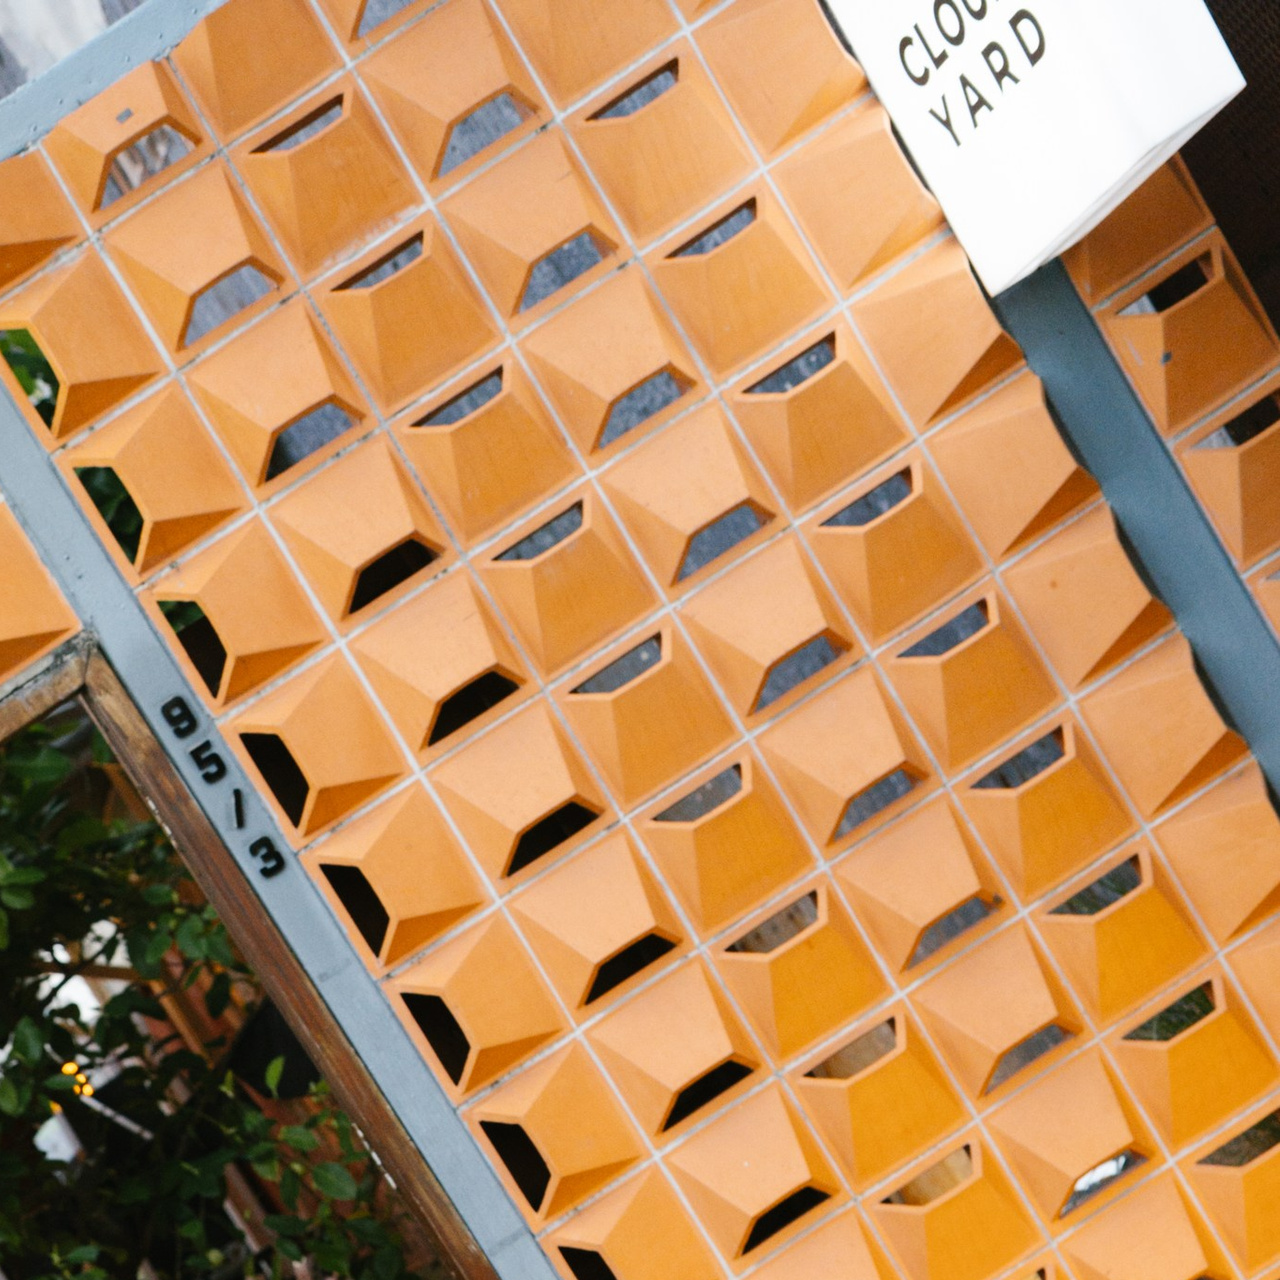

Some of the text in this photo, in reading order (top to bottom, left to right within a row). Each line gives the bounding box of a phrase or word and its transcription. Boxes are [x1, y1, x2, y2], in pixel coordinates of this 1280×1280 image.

[899, 0, 999, 86] CLO
[928, 8, 1046, 147] YARD
[161, 696, 286, 879] 95/3
